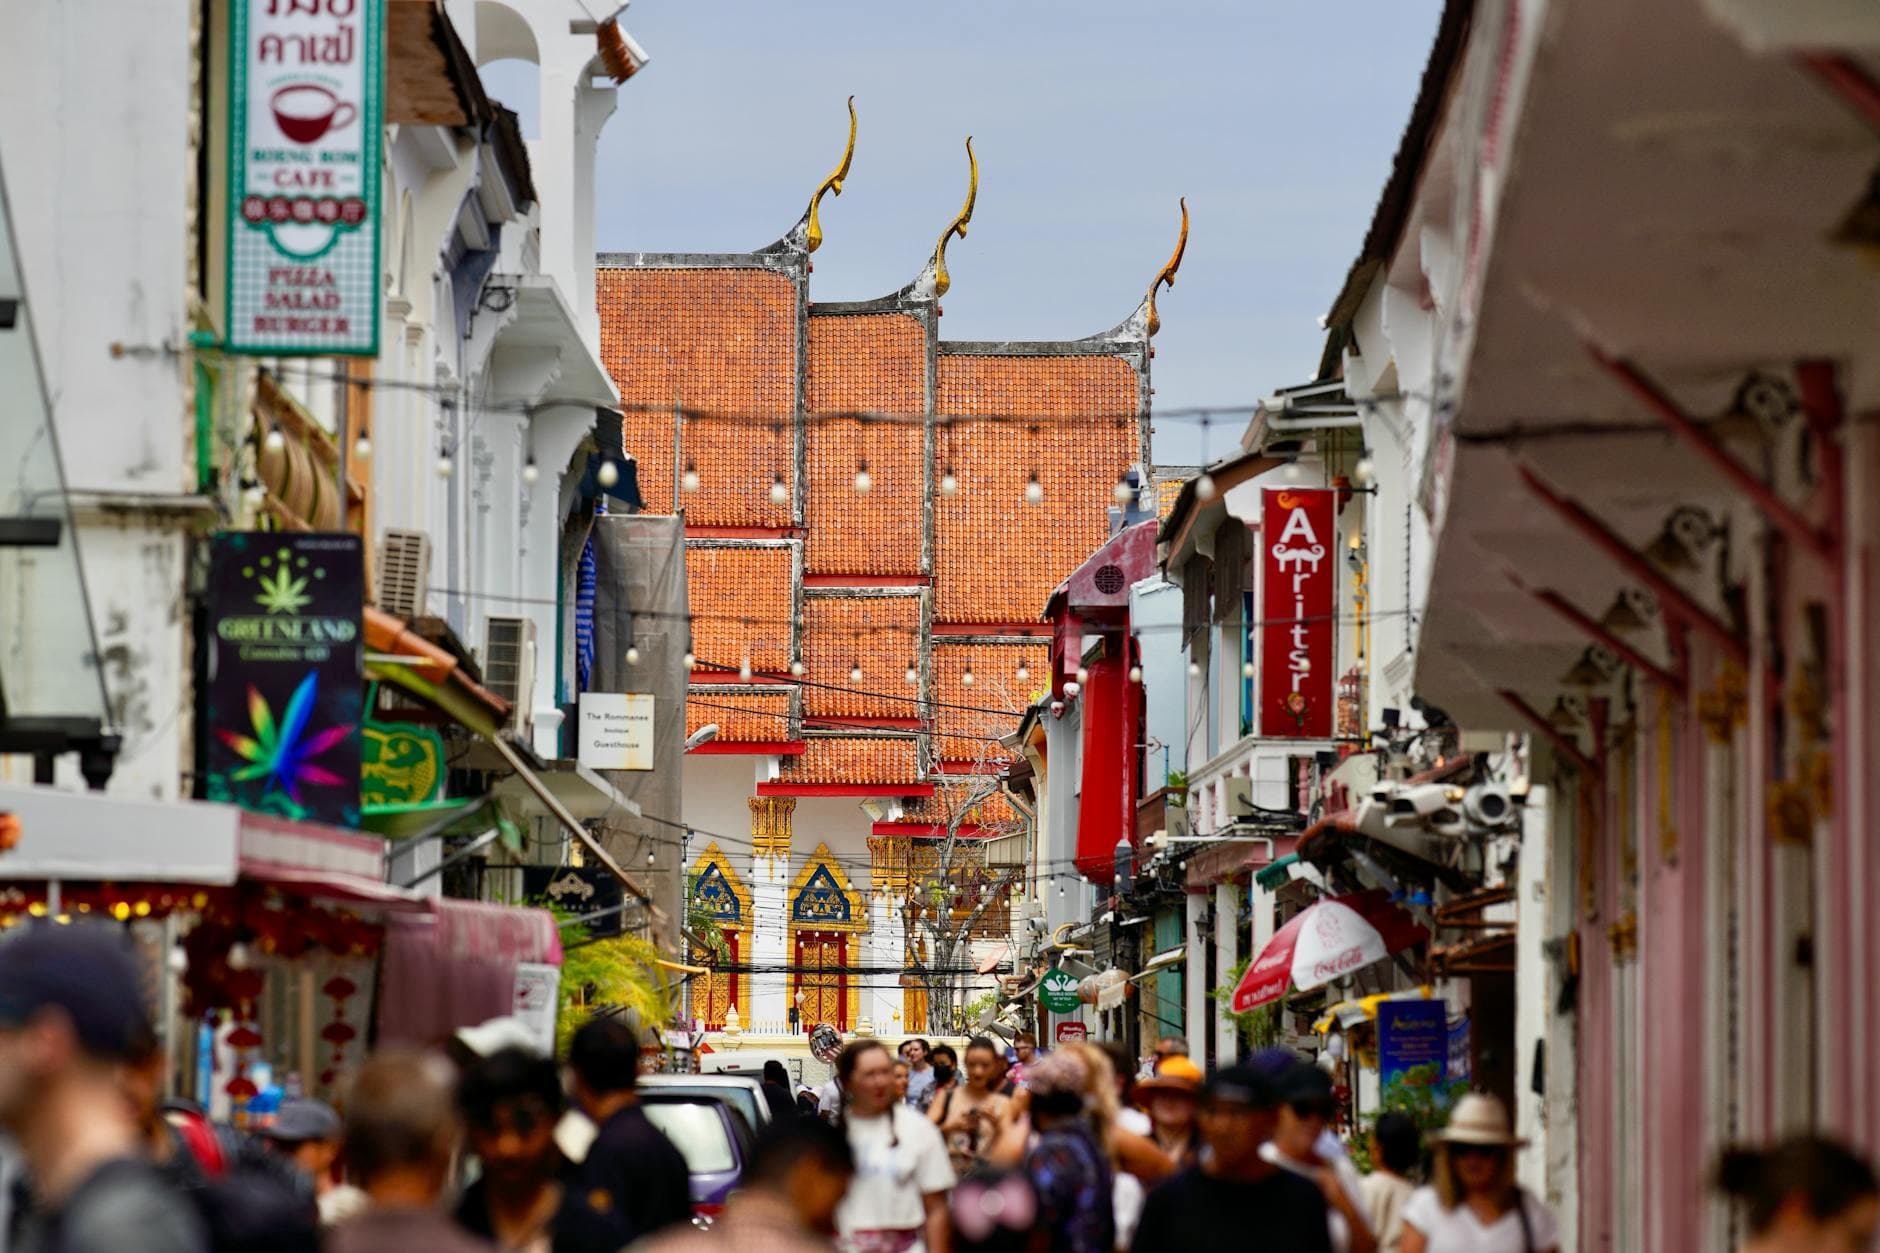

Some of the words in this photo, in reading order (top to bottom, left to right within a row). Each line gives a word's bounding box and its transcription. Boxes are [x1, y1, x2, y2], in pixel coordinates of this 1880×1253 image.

[273, 168, 337, 189] CAFE
[268, 266, 336, 286] PIZZA
[265, 292, 341, 310] SALAD
[253, 316, 350, 334] BURGER
[217, 617, 357, 641] GREENLAND
[587, 711, 601, 720] The
[593, 740, 640, 749] Guesthouse
